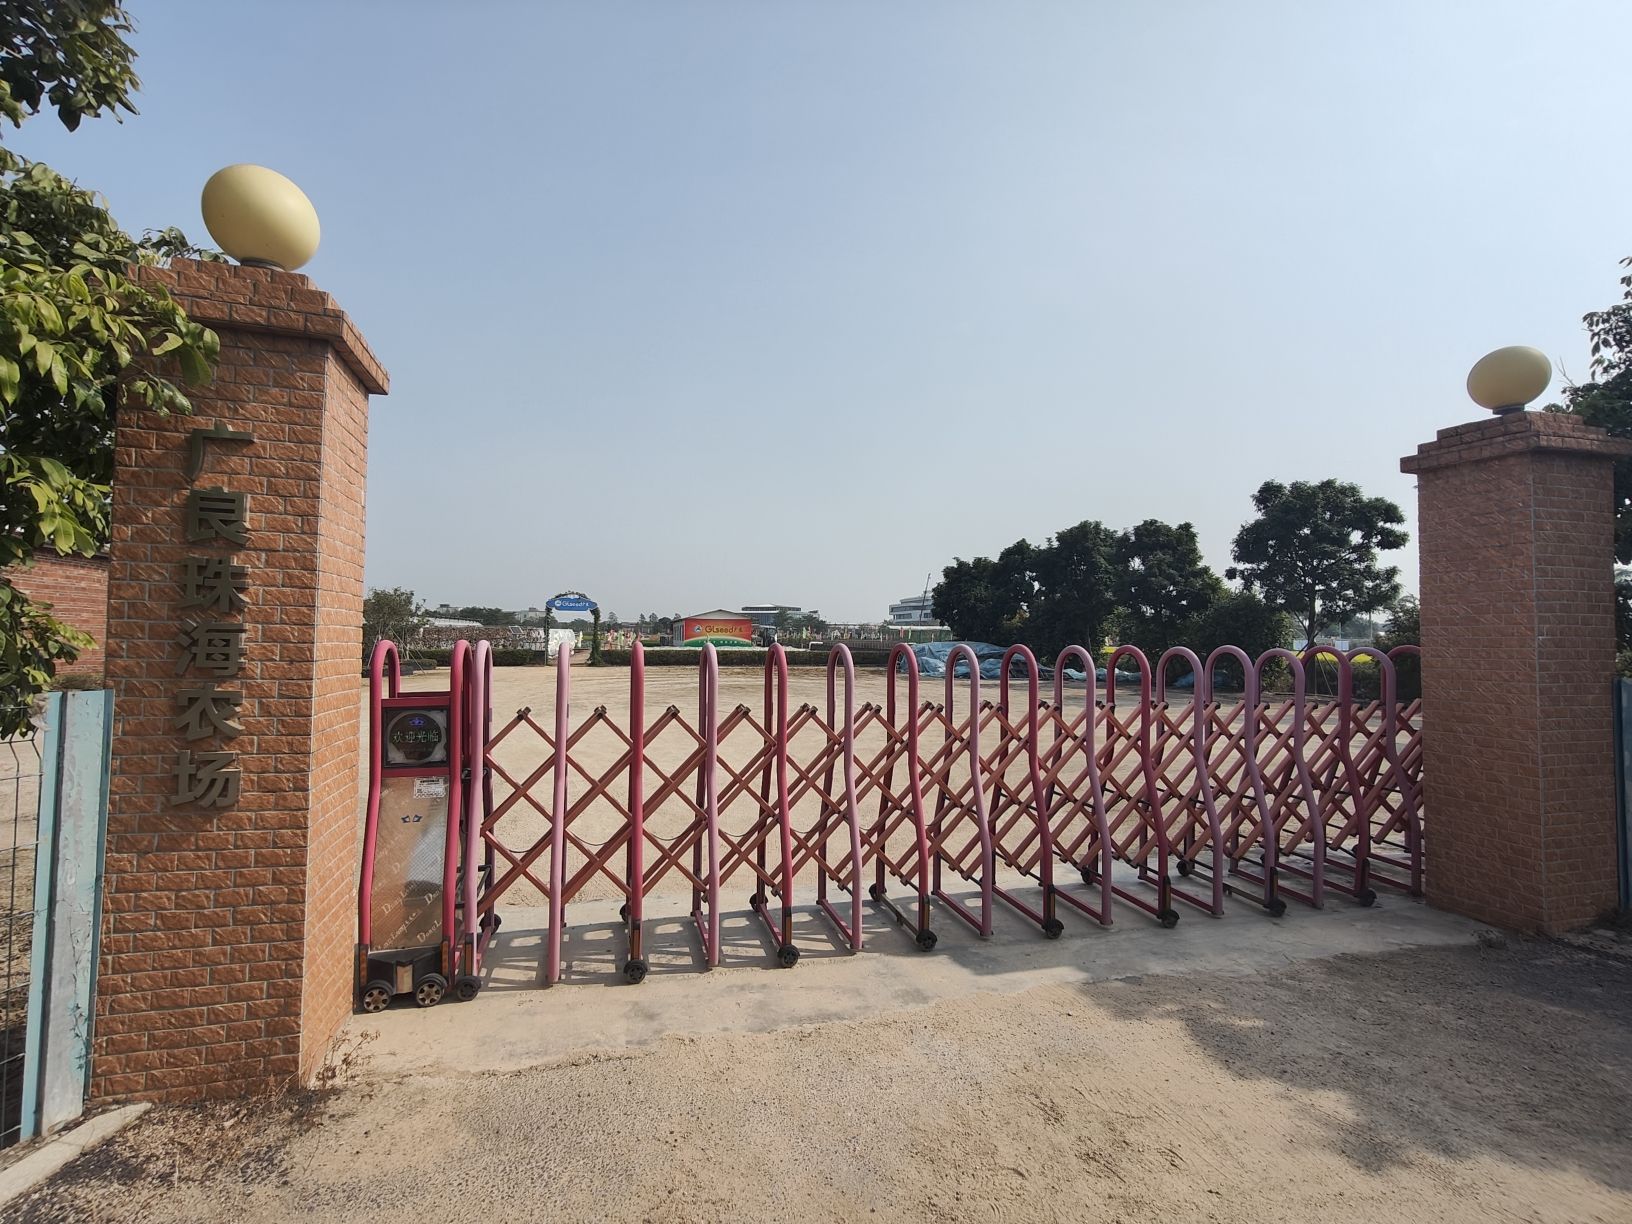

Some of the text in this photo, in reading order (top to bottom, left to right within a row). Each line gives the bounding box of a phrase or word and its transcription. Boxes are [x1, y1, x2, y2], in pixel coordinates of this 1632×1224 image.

[172, 421, 255, 808] 广良珠海农场
[393, 730, 439, 743] 欢迎光临
